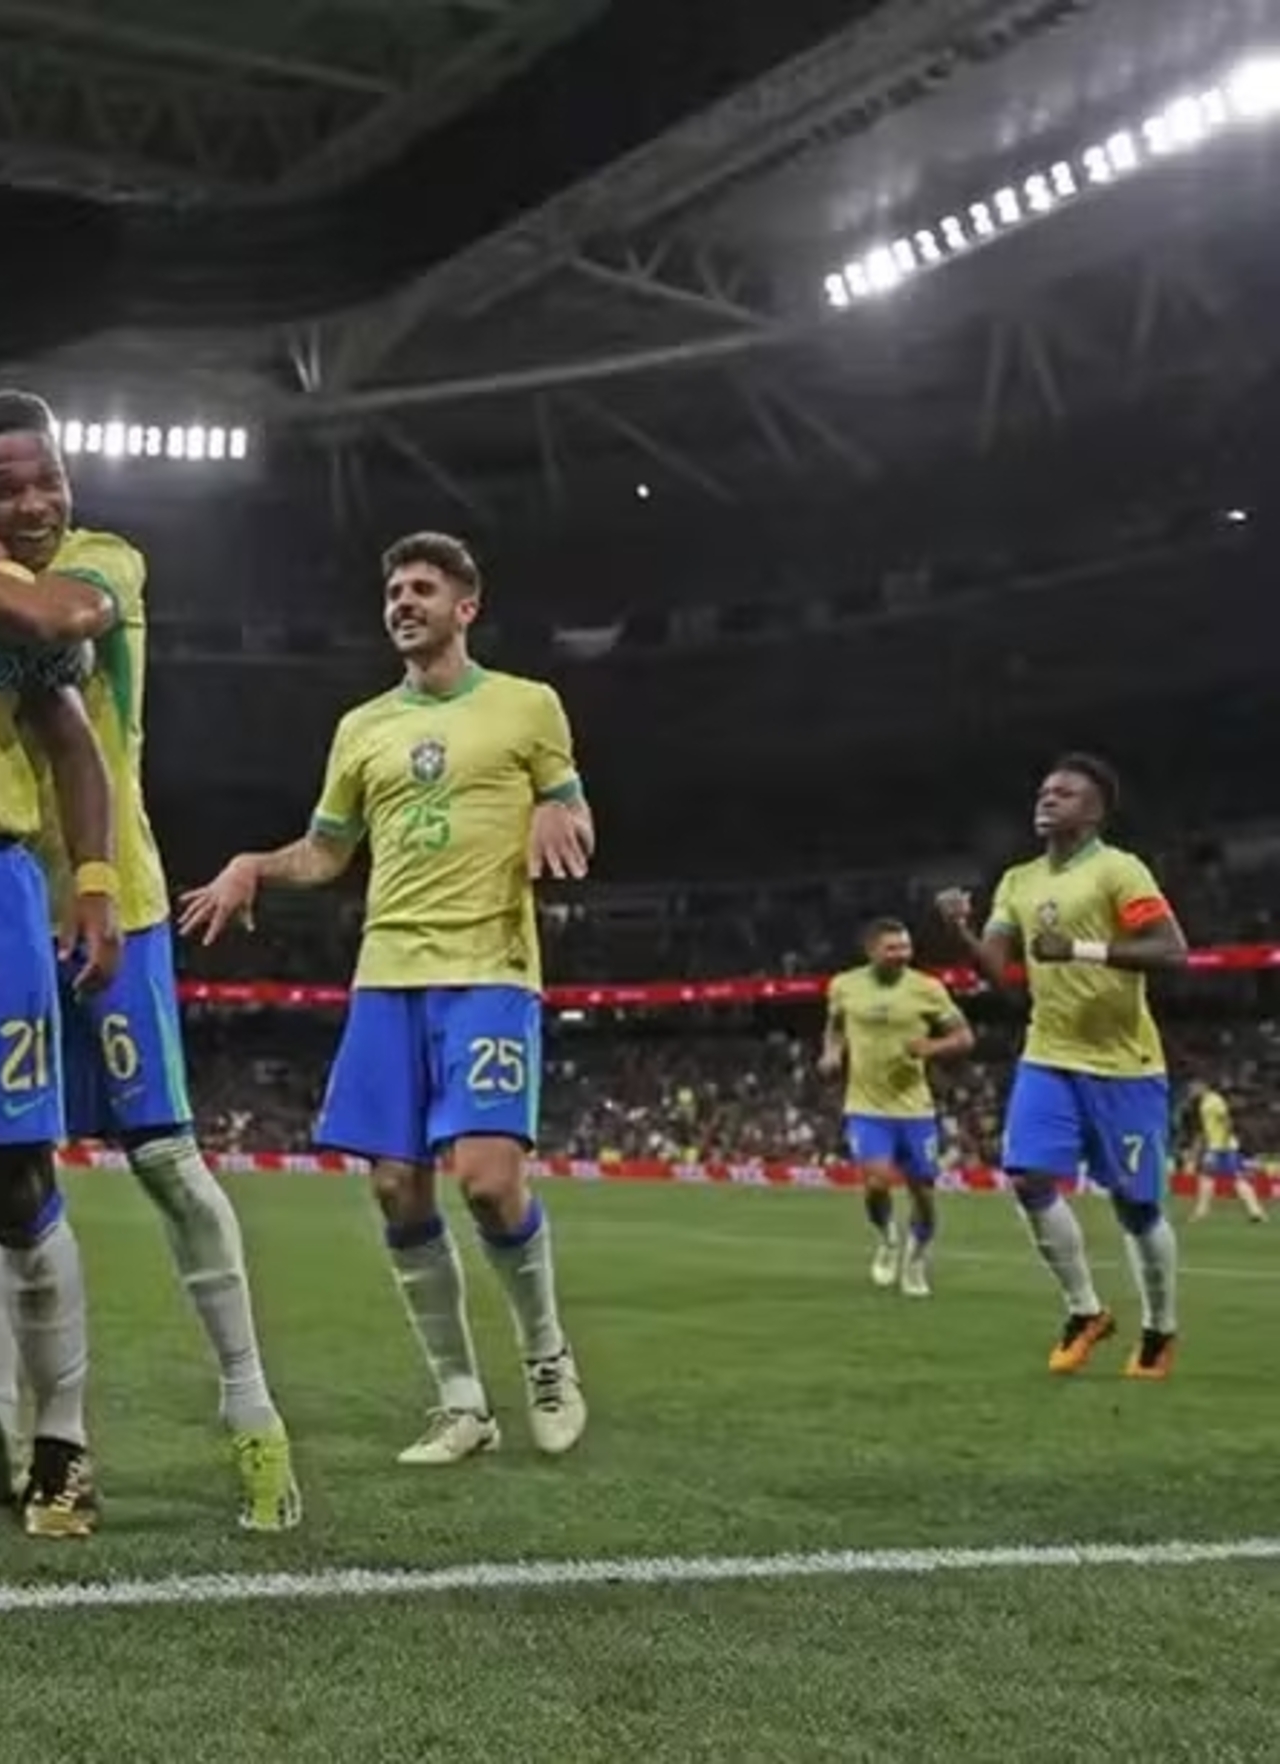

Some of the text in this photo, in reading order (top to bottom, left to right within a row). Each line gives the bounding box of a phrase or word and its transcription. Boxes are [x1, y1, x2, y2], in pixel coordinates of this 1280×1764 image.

[402, 800, 451, 850] 25
[102, 1013, 138, 1079] 6
[466, 1037, 525, 1093] 25
[1122, 1135, 1145, 1173] 7
